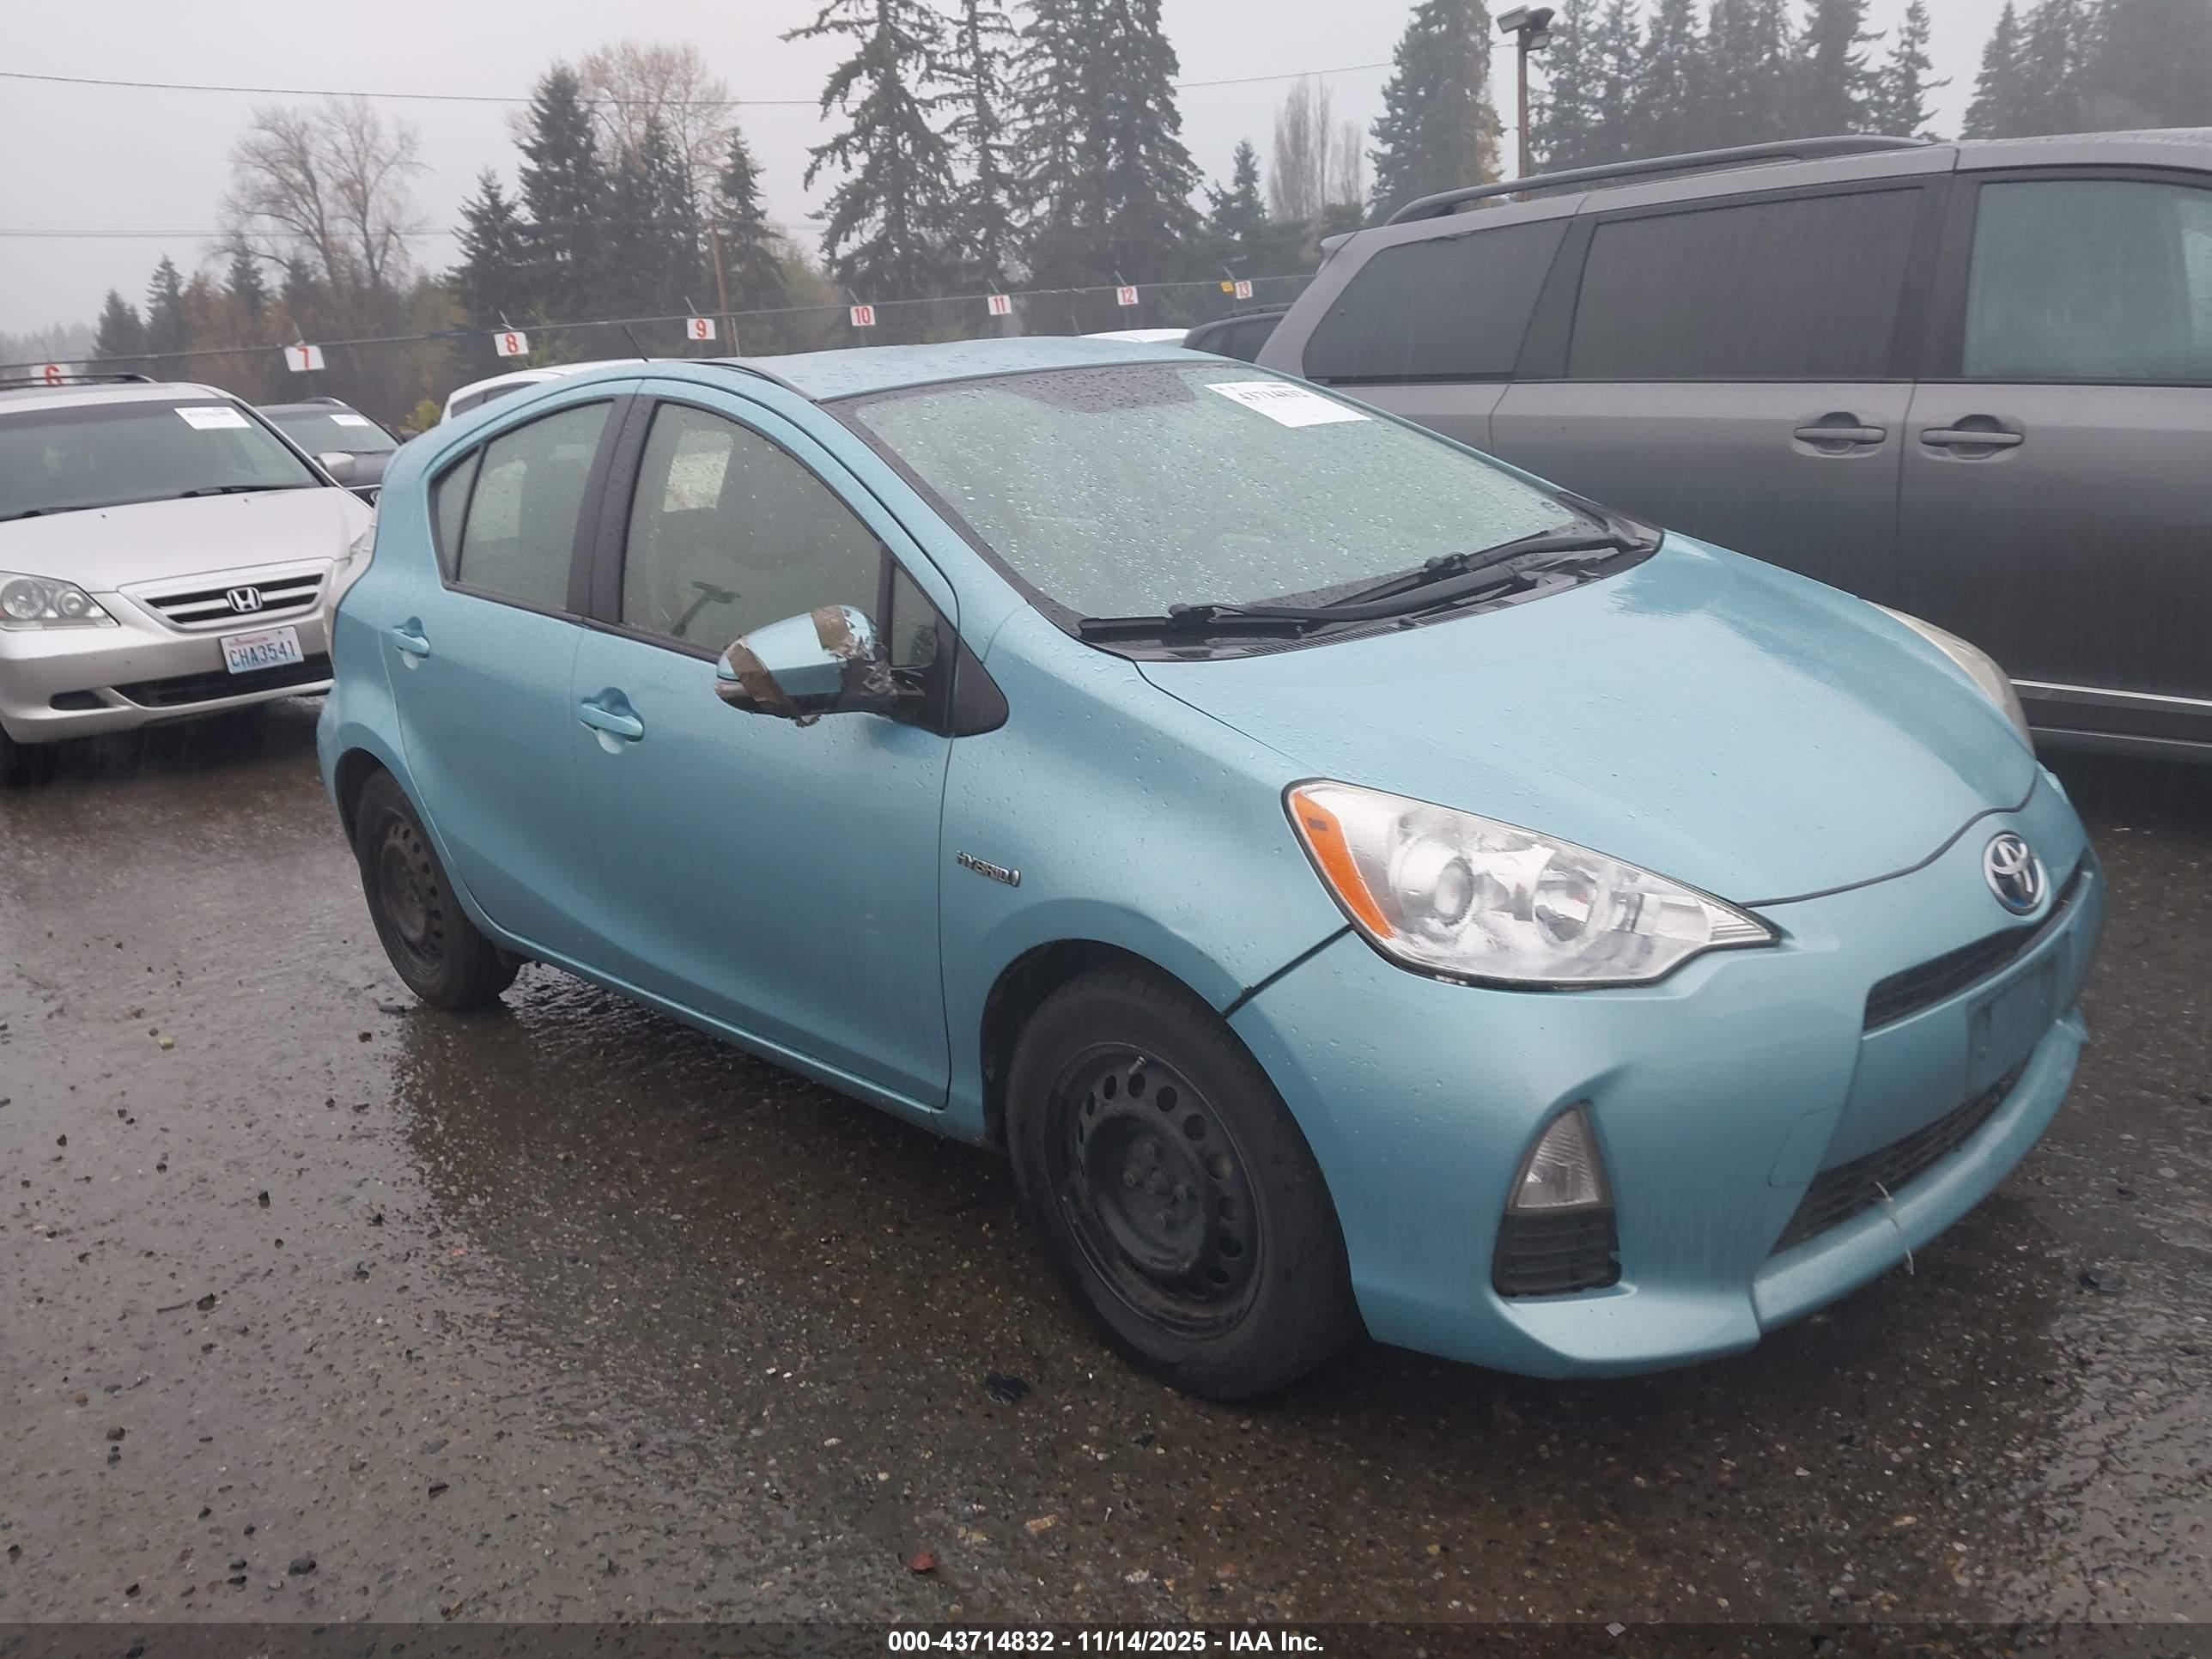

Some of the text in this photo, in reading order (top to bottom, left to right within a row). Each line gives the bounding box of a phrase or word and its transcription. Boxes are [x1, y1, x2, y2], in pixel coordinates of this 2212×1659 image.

[993, 296, 1008, 313] 11
[1120, 287, 1135, 304] 12
[855, 306, 872, 325] 10
[695, 319, 708, 338] 9
[504, 332, 519, 354] 8
[296, 345, 310, 371] 7
[44, 364, 62, 386] 6
[228, 641, 297, 667] CHA3541
